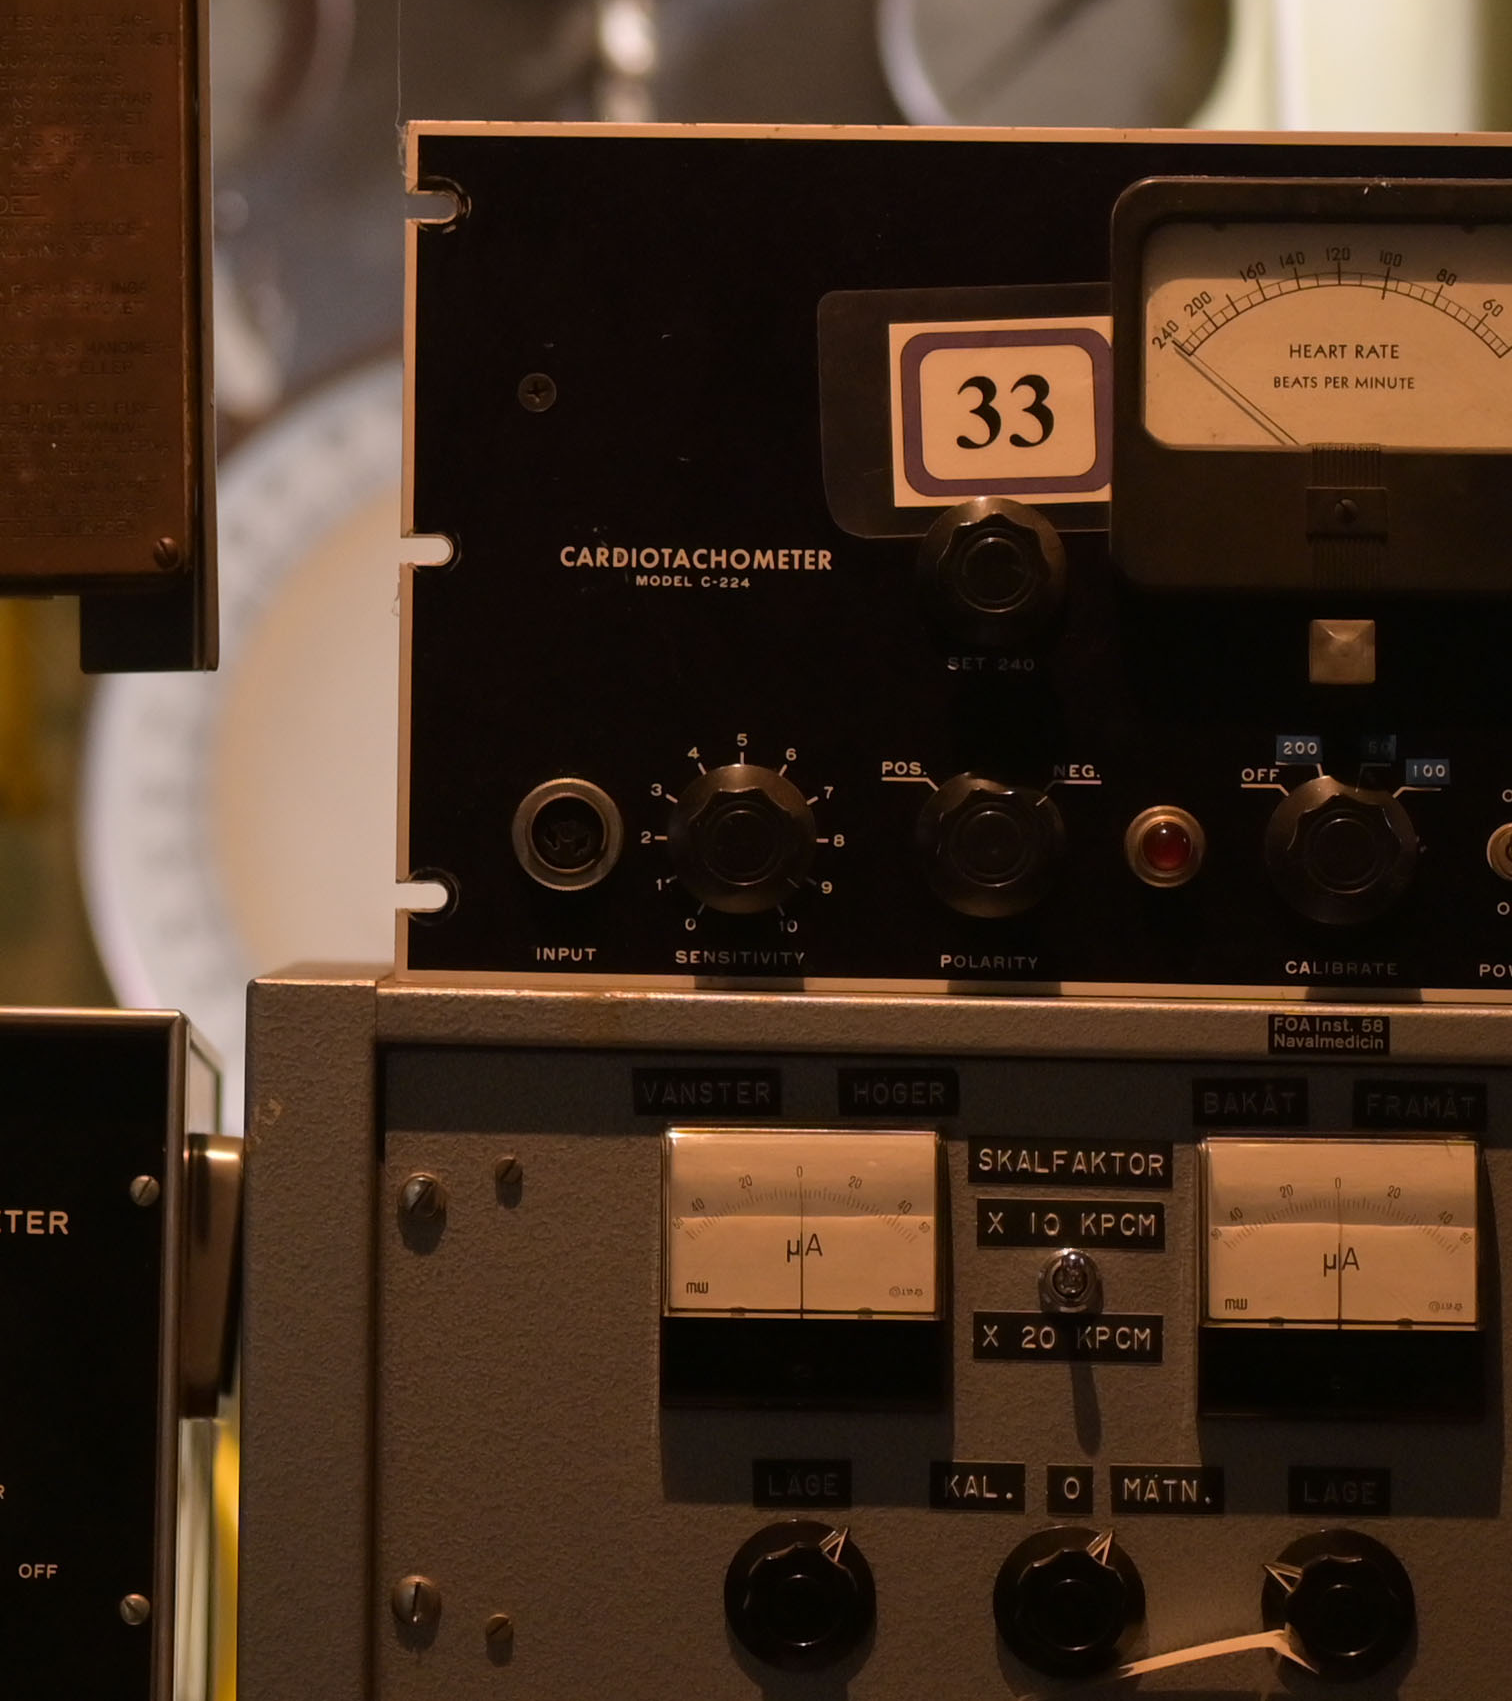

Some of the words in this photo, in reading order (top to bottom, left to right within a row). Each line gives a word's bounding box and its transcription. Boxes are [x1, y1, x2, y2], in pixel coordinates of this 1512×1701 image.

[1182, 291, 1213, 319] 200
[1239, 261, 1267, 281] 160
[1324, 247, 1351, 264] 120
[1378, 250, 1403, 268] 100
[1436, 269, 1458, 287] 80
[1483, 299, 1504, 319] 60
[1289, 343, 1348, 359] HEART
[1354, 343, 1400, 360] RATE
[1273, 375, 1318, 389] BEATS
[1324, 375, 1350, 389] PER
[1354, 376, 1415, 390] MINUTE
[956, 374, 1055, 450] 33
[560, 546, 832, 571] CARDIOTACHOMETER
[635, 574, 693, 588] MODEL
[700, 575, 751, 589] C-224
[947, 657, 987, 671] SET
[997, 657, 1036, 671] 240
[1283, 741, 1318, 755] 200
[881, 760, 927, 776] POS.
[1053, 763, 1101, 779] NEG.
[1241, 767, 1280, 783] OFF
[1413, 764, 1445, 779] 100
[536, 947, 597, 962] INPUT
[675, 949, 805, 965] SENSITIVITY
[940, 954, 1038, 970] POLARITY
[1285, 960, 1398, 976] CALIBRATE
[1273, 1016, 1311, 1032] FOA
[1315, 1016, 1358, 1033] Inst.
[1362, 1019, 1384, 1034] 58
[1273, 1034, 1386, 1051] Navalmedicin
[978, 1147, 1164, 1176] SKALFAKTOR
[987, 1211, 1004, 1234] X
[1031, 1211, 1060, 1236] 10
[1081, 1212, 1156, 1236] KPCM
[982, 1324, 999, 1348] X
[1021, 1325, 1056, 1350] 20
[1076, 1326, 1152, 1352] KPCM
[942, 1473, 1015, 1501] KAL.
[1122, 1469, 1213, 1506] MÄTN.
[18, 1563, 58, 1579] OFF
